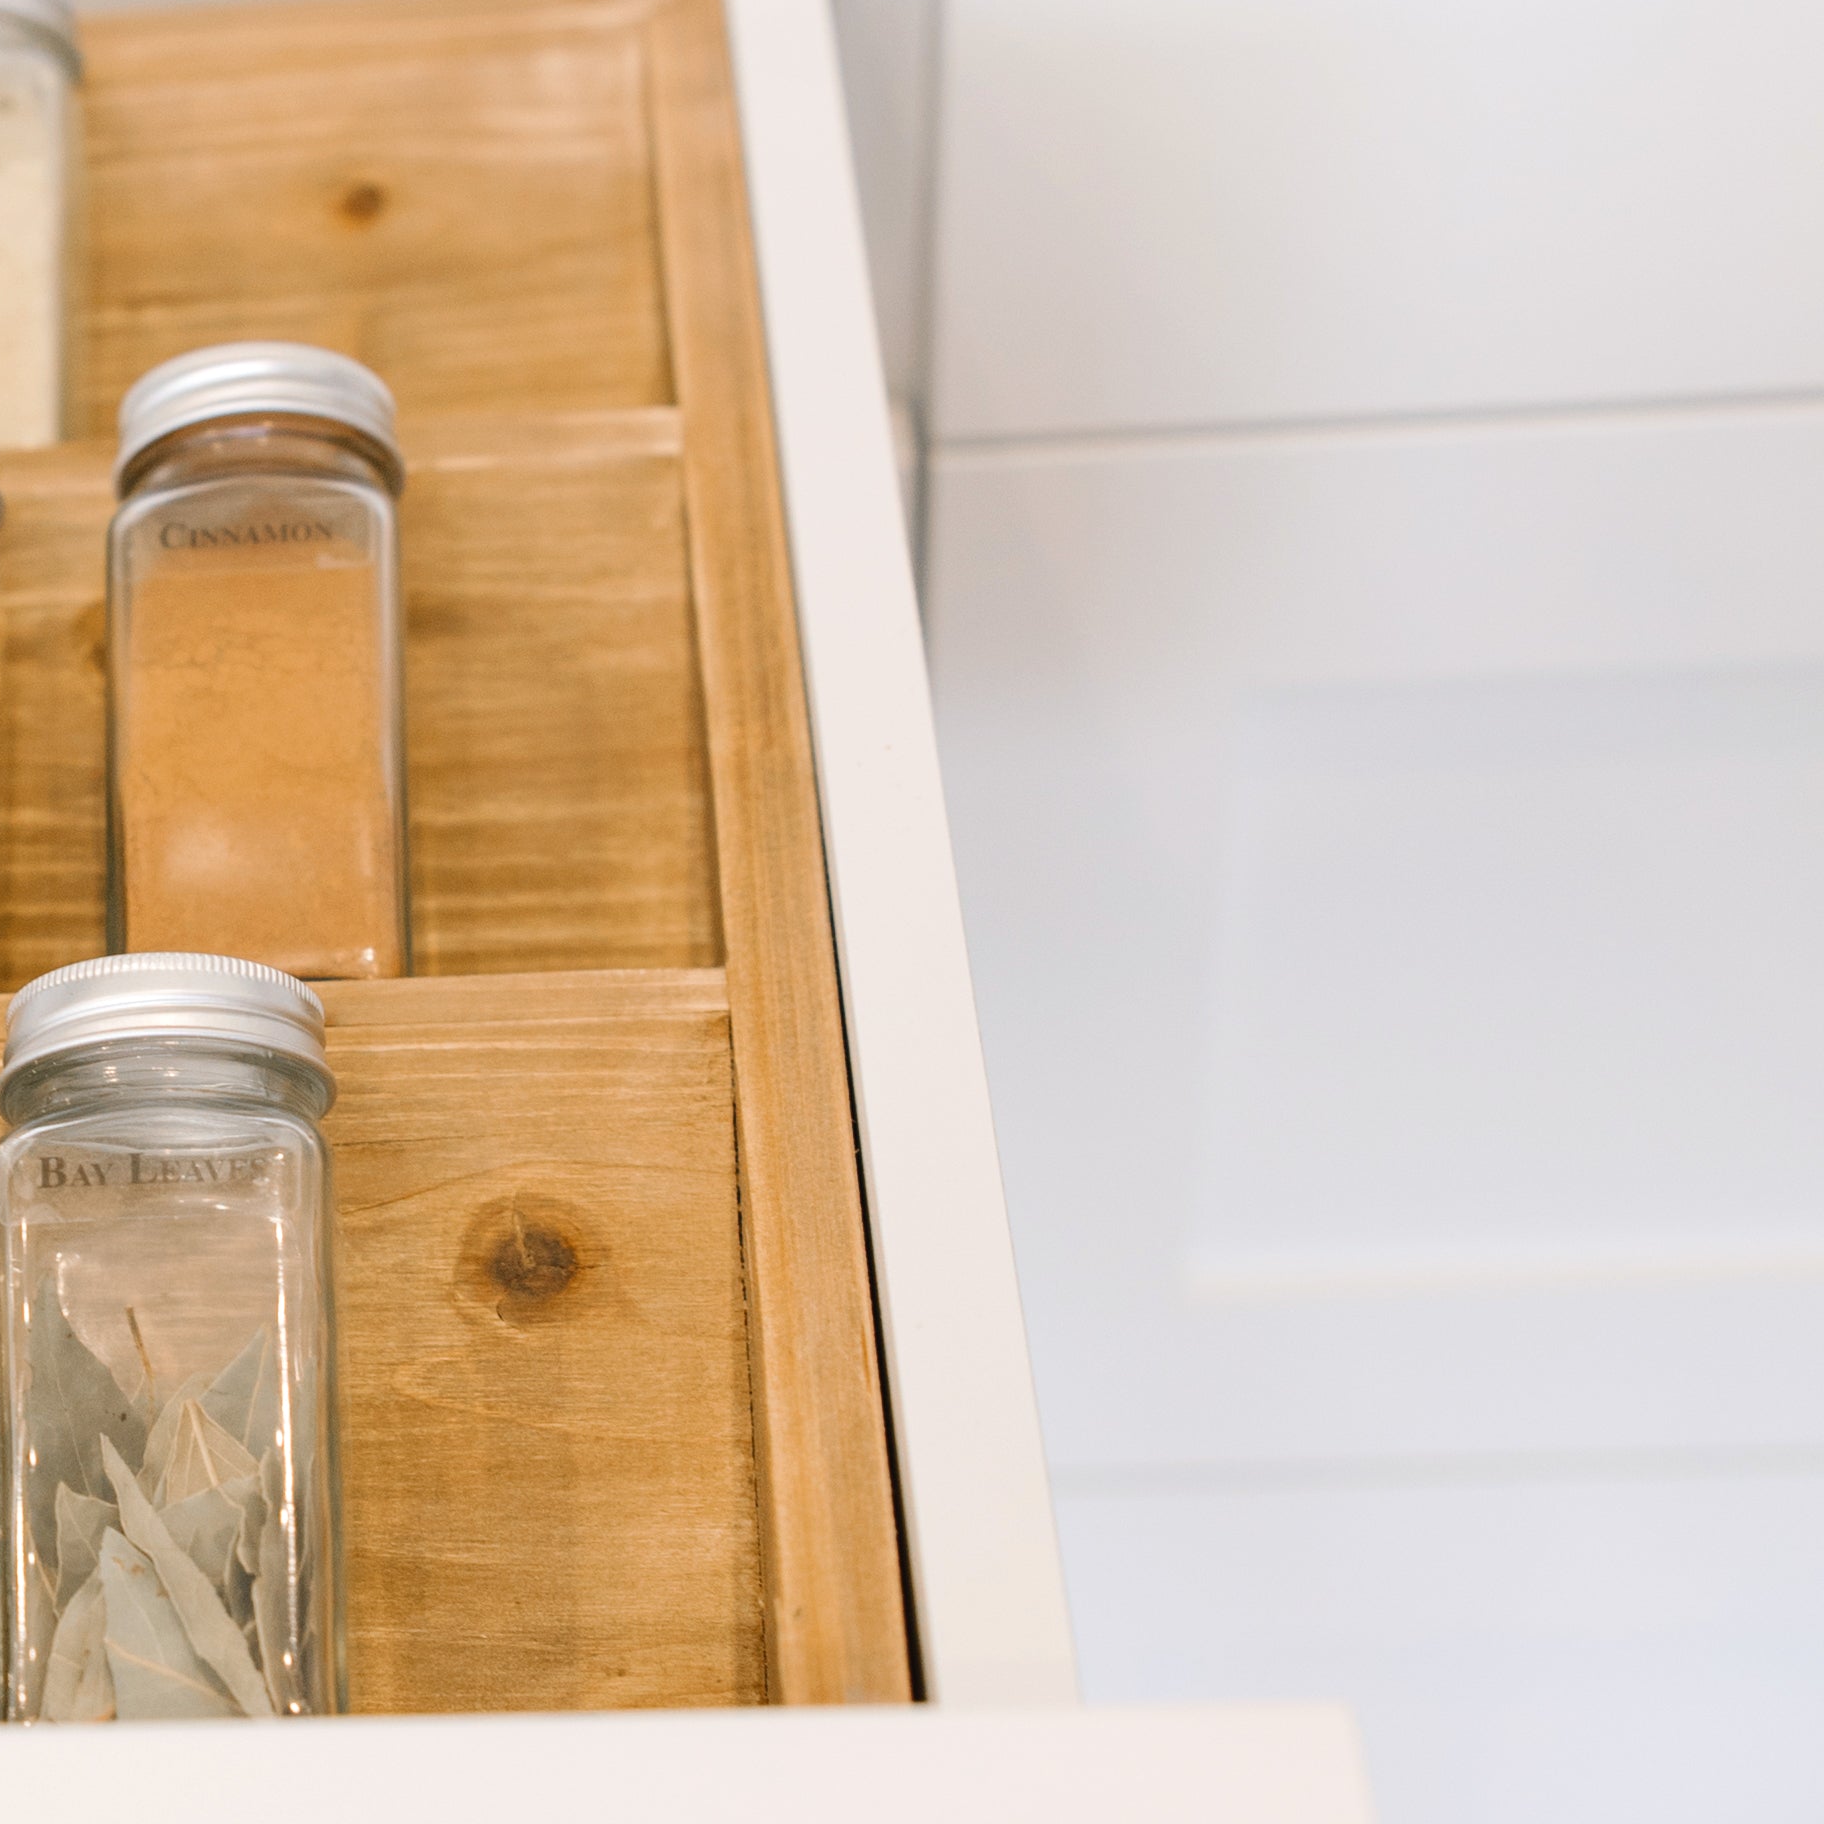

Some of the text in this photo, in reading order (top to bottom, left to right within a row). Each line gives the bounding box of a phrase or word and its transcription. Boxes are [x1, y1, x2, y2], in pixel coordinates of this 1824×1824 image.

[160, 522, 334, 550] CINNAMON
[39, 1151, 268, 1189] BAY LEAVES
